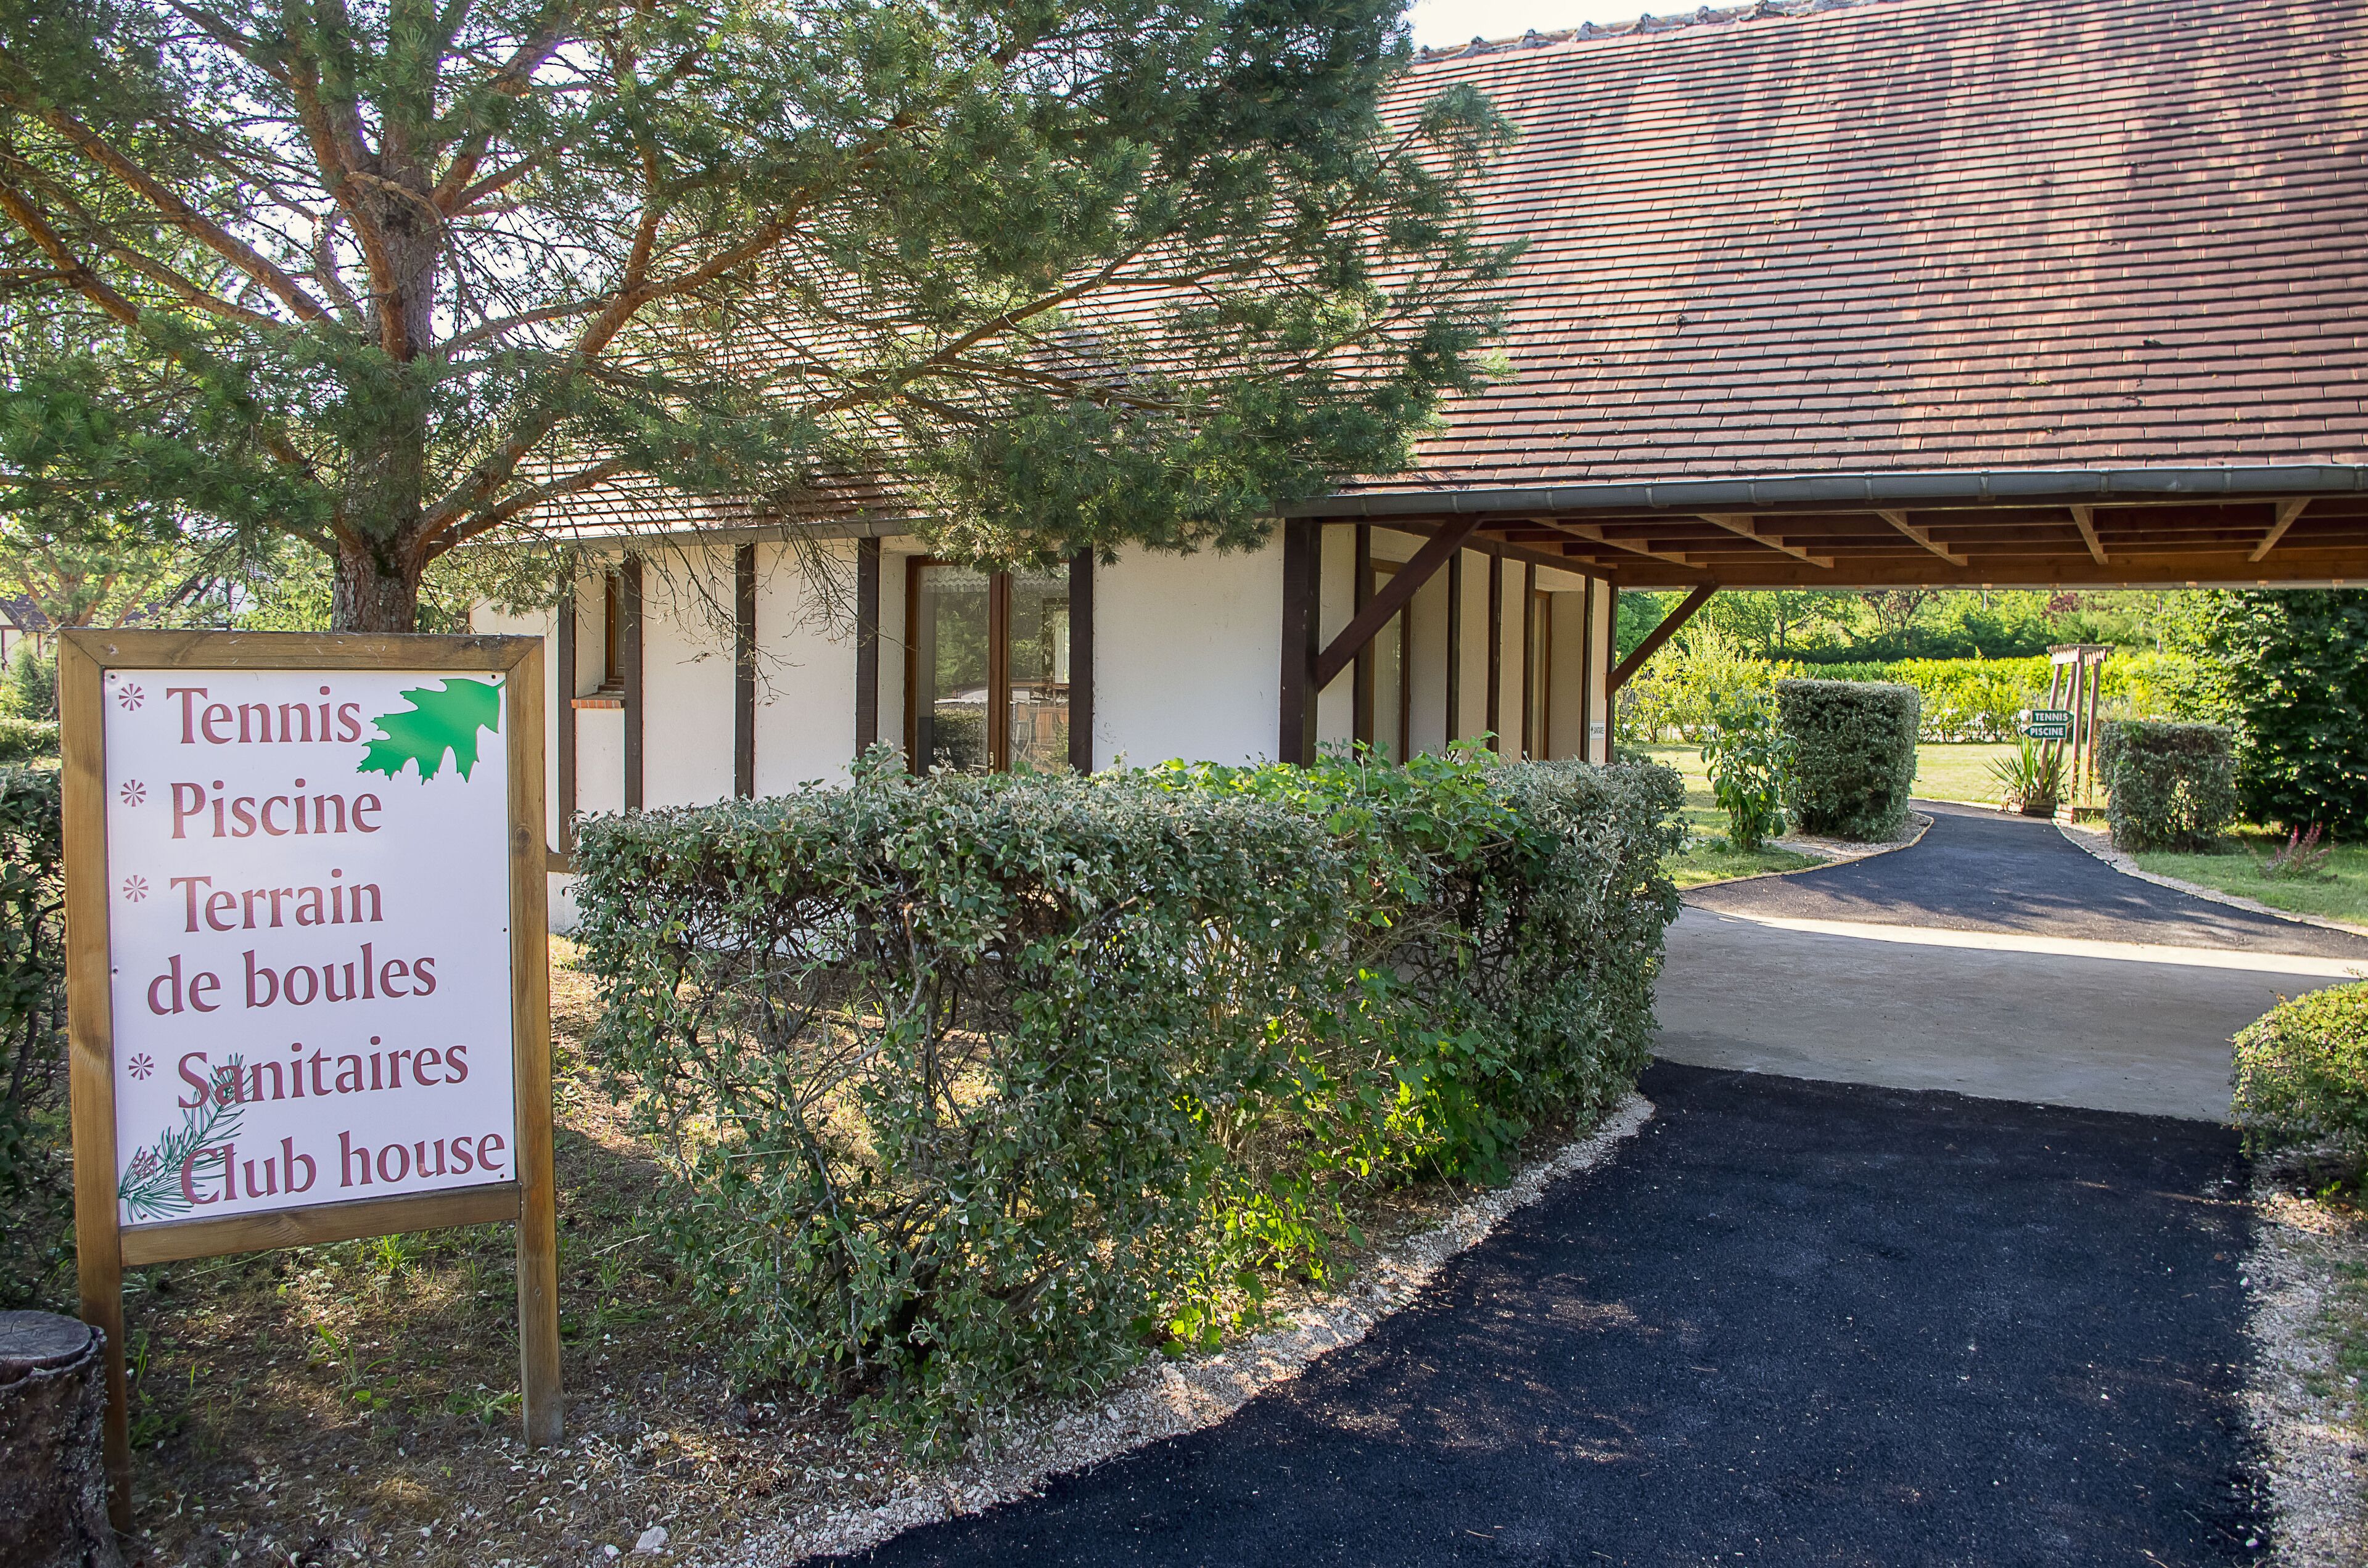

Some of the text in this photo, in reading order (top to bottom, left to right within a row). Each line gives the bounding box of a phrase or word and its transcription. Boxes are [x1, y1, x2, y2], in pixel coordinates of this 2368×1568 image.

[166, 686, 361, 744] Tennis
[2030, 728, 2063, 736] PISCINE
[2034, 712, 2068, 721] TENNIS
[171, 778, 382, 839] Piscine
[170, 868, 384, 933] Terrain
[147, 942, 437, 1016] de boules
[178, 1036, 469, 1109] Sanitaires
[180, 1130, 506, 1205] Club house
